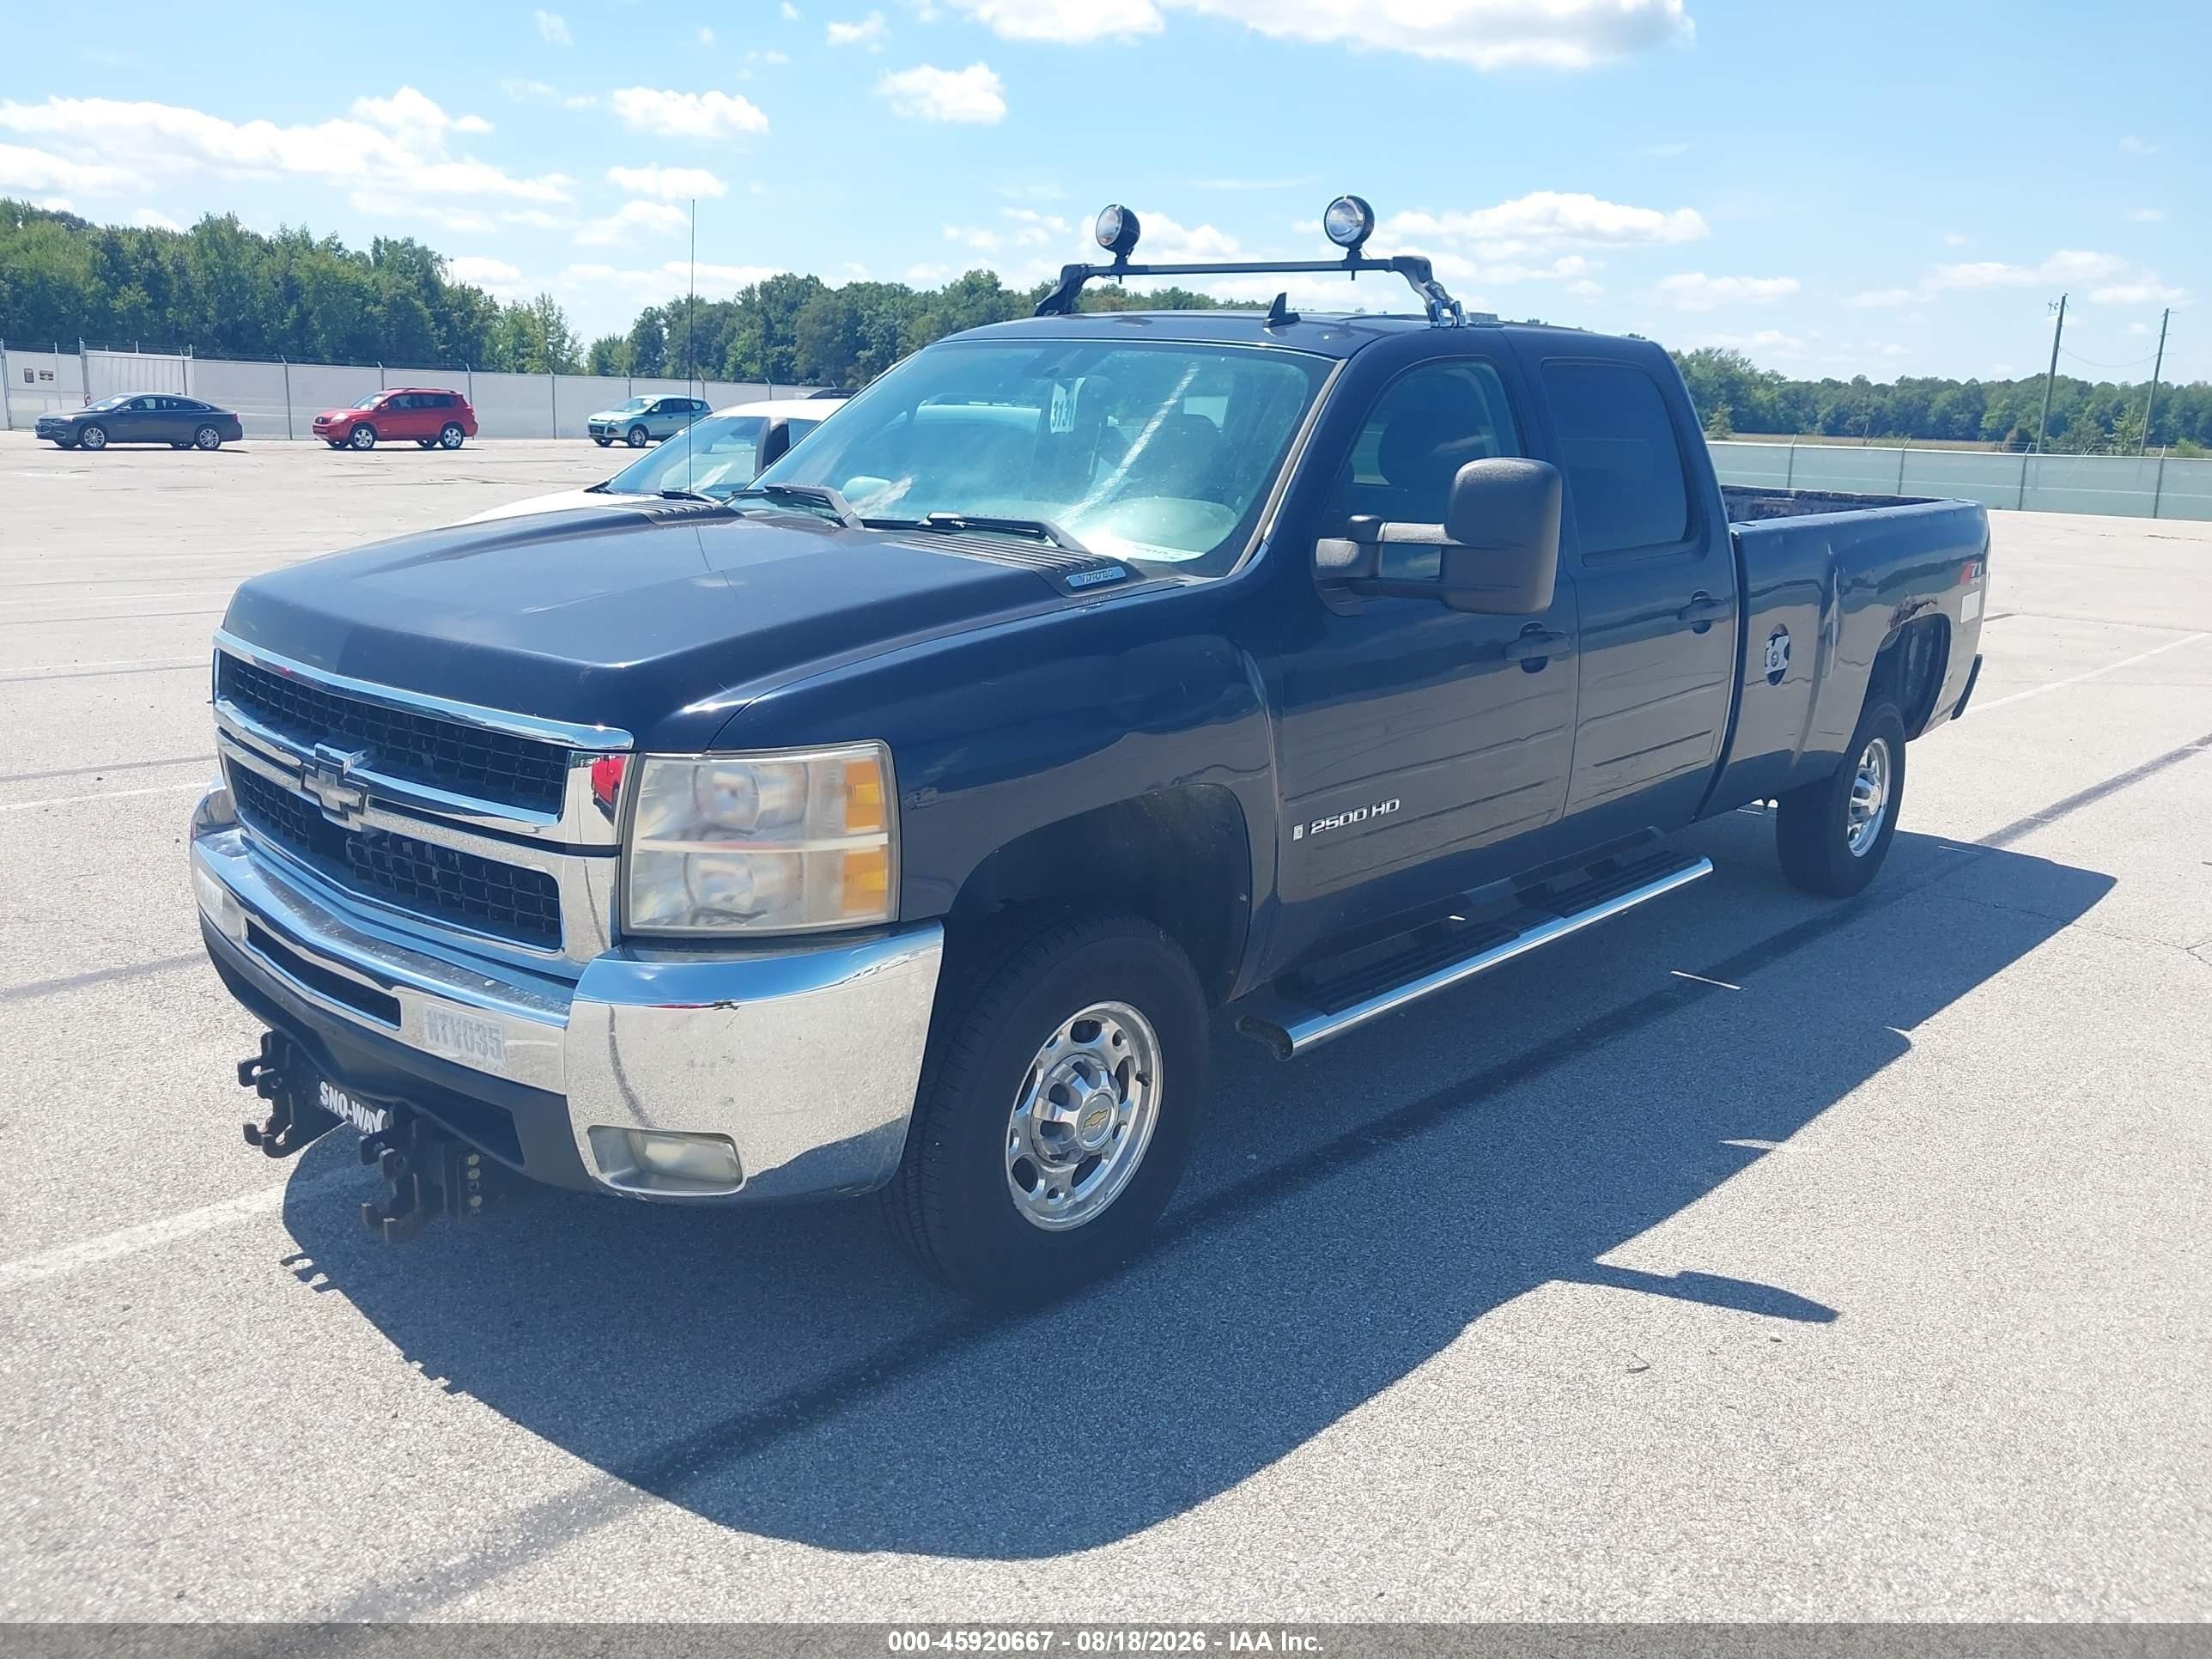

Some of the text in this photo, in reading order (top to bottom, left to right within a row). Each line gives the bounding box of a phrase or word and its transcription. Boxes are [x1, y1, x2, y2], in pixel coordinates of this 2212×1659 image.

[1310, 805, 1369, 835] 2500
[1370, 797, 1401, 818] HD
[319, 1080, 388, 1134] SNO-WAY
